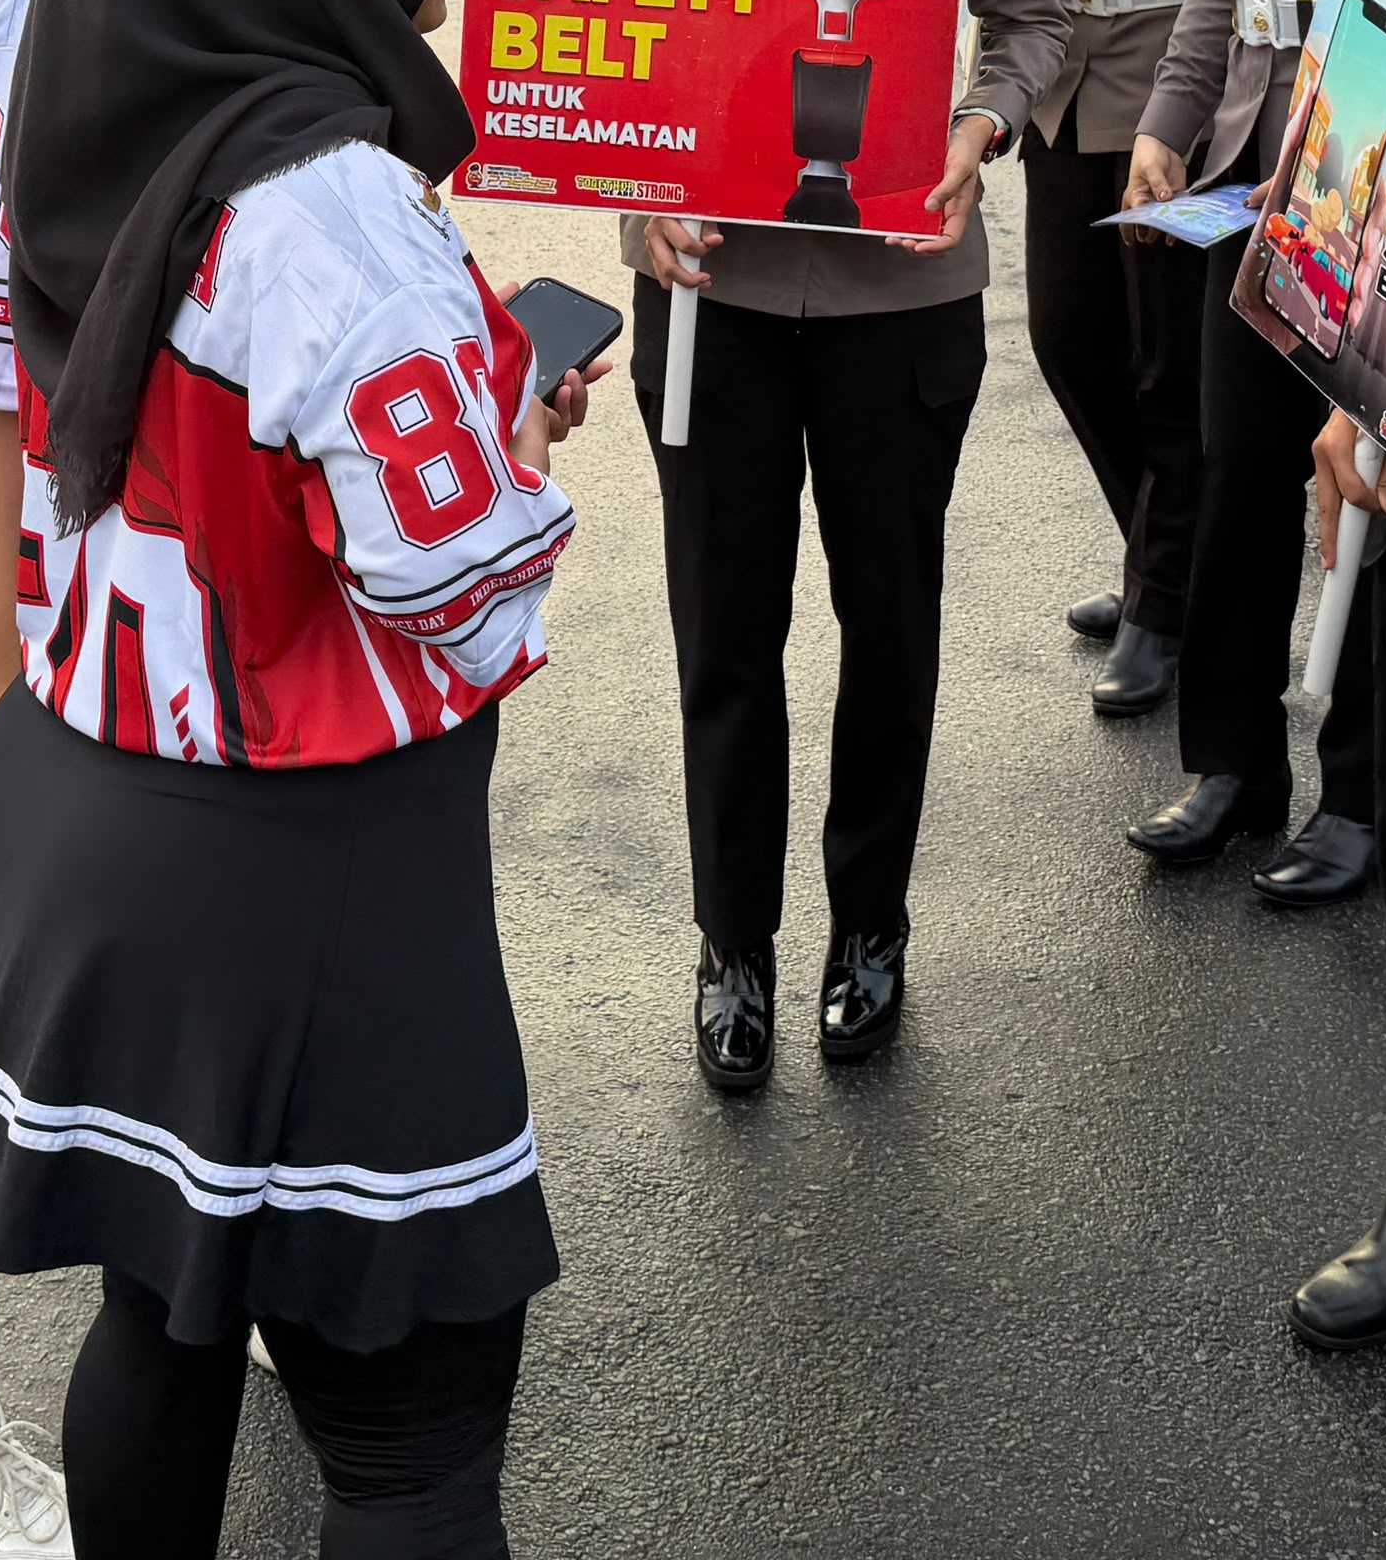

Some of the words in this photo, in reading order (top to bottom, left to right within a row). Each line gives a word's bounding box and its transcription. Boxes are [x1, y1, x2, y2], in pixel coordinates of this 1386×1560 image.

[490, 10, 667, 81] BELT
[487, 79, 585, 111] UNTUK
[484, 111, 697, 152] KESELAMATAN
[636, 182, 683, 201] STRONG
[420, 612, 447, 631] DAY
